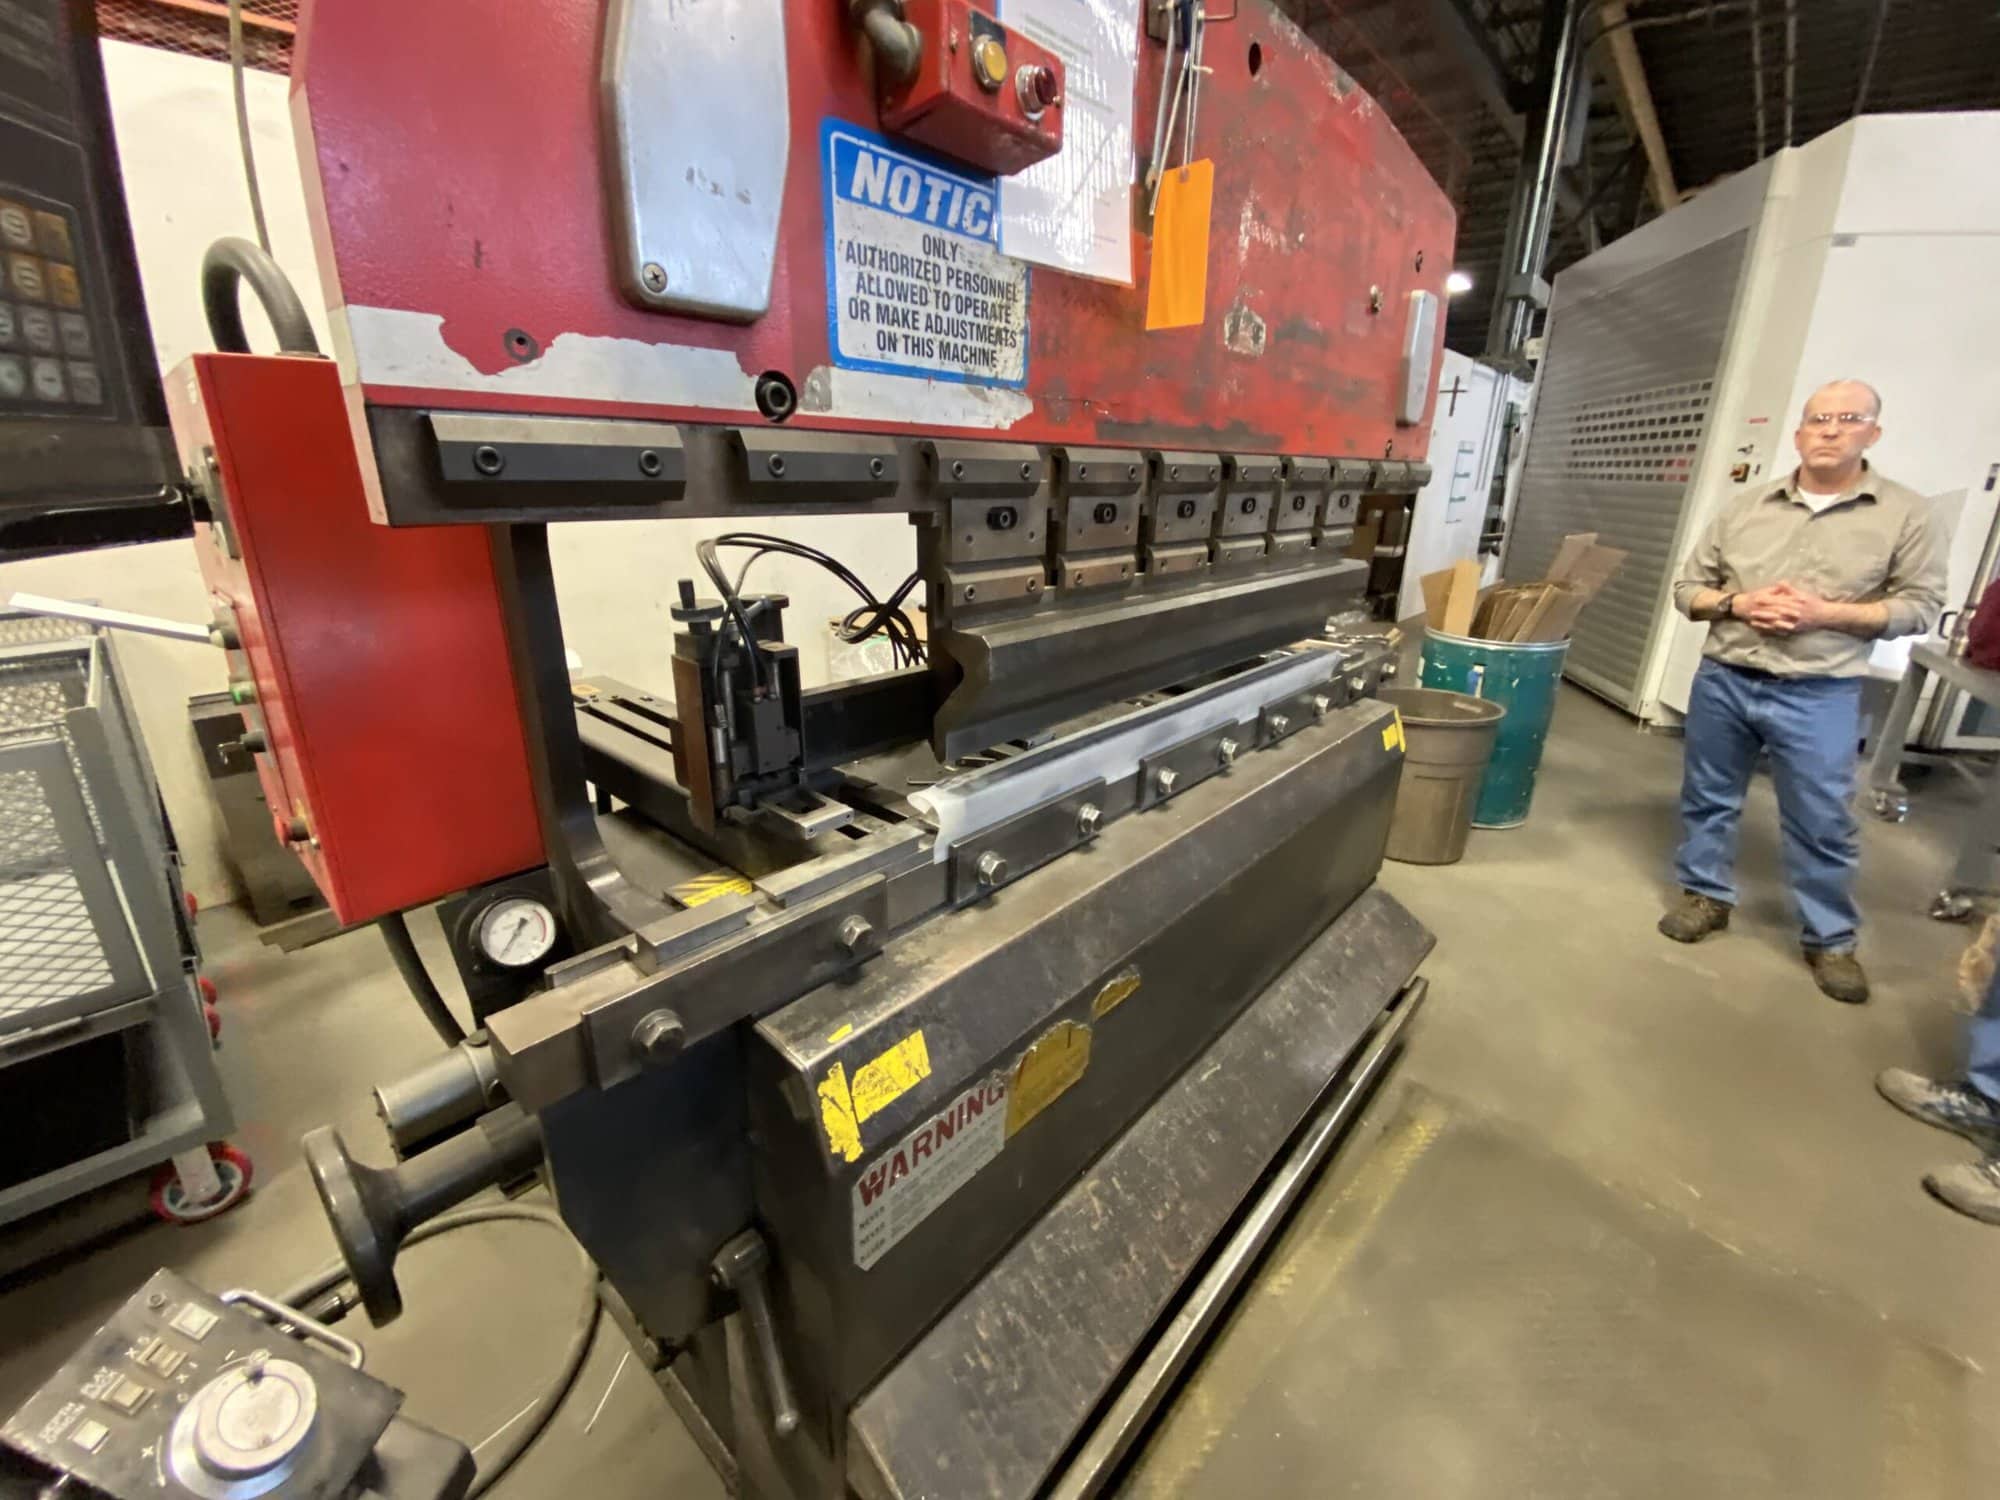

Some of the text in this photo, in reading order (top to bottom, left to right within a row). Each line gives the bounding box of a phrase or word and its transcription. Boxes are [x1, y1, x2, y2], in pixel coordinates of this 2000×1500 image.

[851, 150, 994, 239] NOTIC
[845, 240, 1018, 303] AUTHORIZED PERSONNEL
[922, 233, 959, 262] ONLY
[848, 297, 1017, 348] OR MAKE ADJUSTMENTS
[856, 271, 1012, 324] ALLOWED TO OPERATE
[876, 330, 998, 368] ON THIS MACHINE
[858, 1078, 1006, 1208] WARNING
